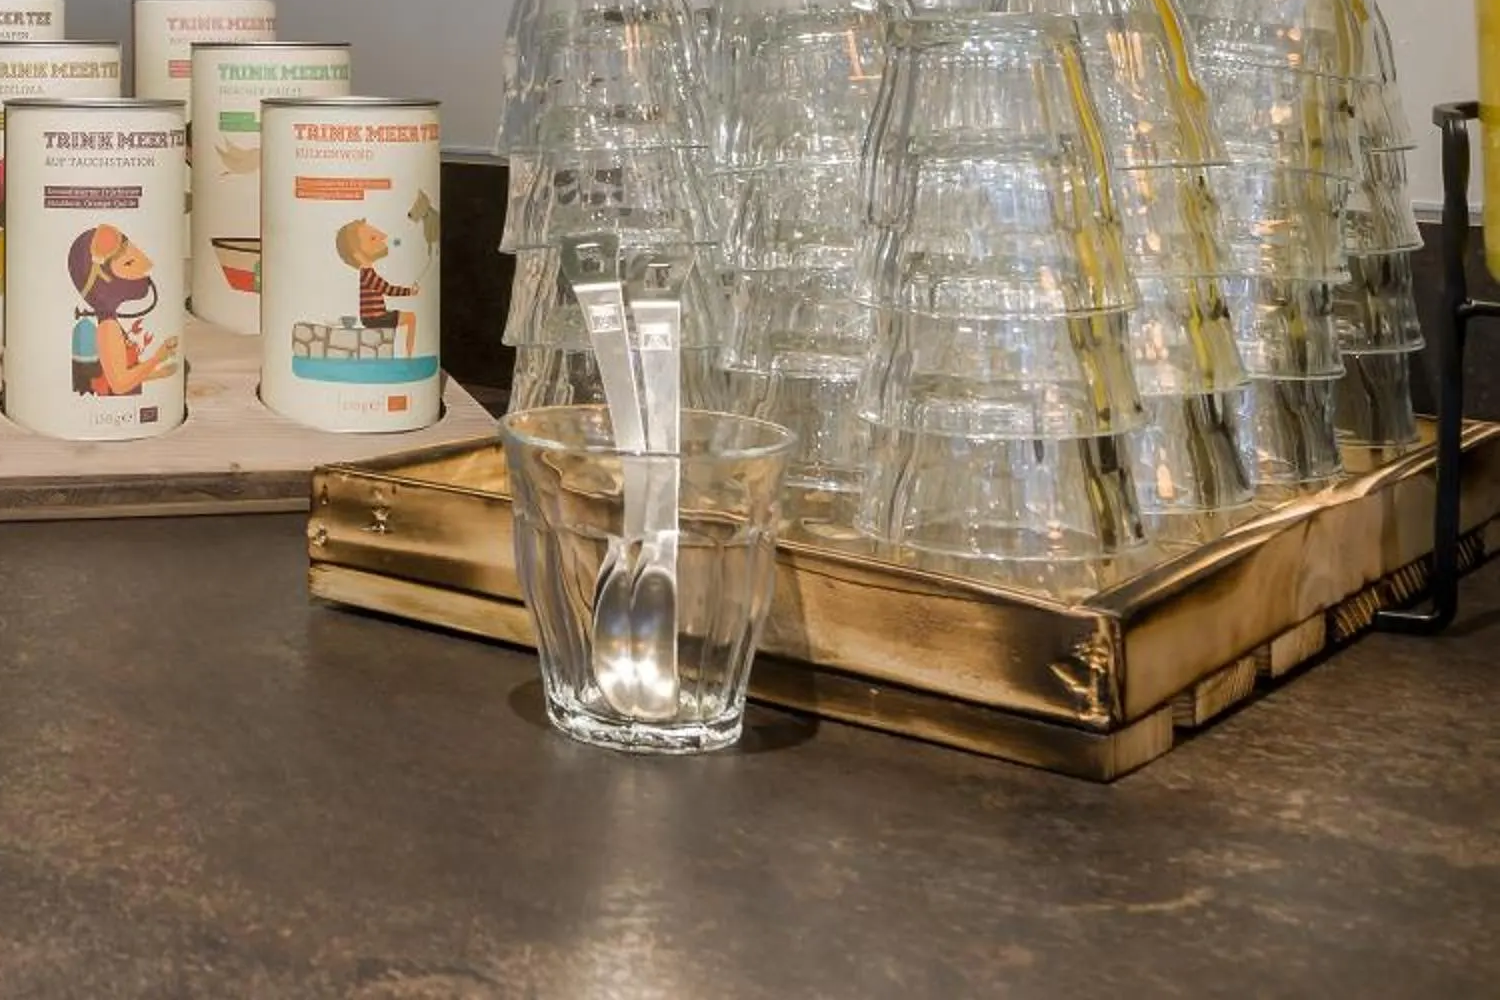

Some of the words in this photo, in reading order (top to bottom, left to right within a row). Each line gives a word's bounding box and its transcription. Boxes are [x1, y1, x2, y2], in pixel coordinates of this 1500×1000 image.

[218, 63, 278, 81] TRINK
[43, 131, 114, 150] TRINK
[117, 131, 168, 149] MEER
[293, 123, 363, 143] TRINK
[365, 124, 419, 143] MEER
